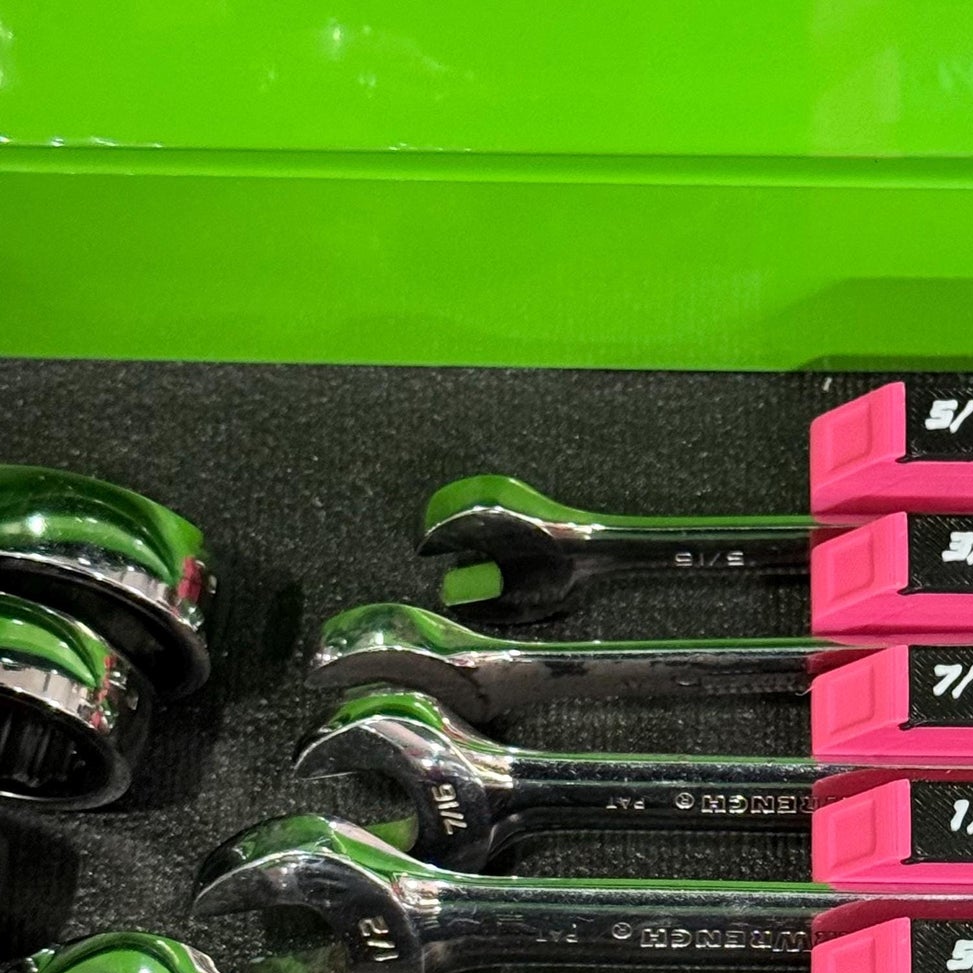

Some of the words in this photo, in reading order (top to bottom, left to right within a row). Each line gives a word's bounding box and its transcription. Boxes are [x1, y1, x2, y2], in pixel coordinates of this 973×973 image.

[432, 784, 468, 835] 7/16
[605, 795, 646, 810] PAT
[701, 795, 820, 815] RENCH
[358, 915, 399, 962] 1/2
[639, 928, 815, 953] WRENCH
